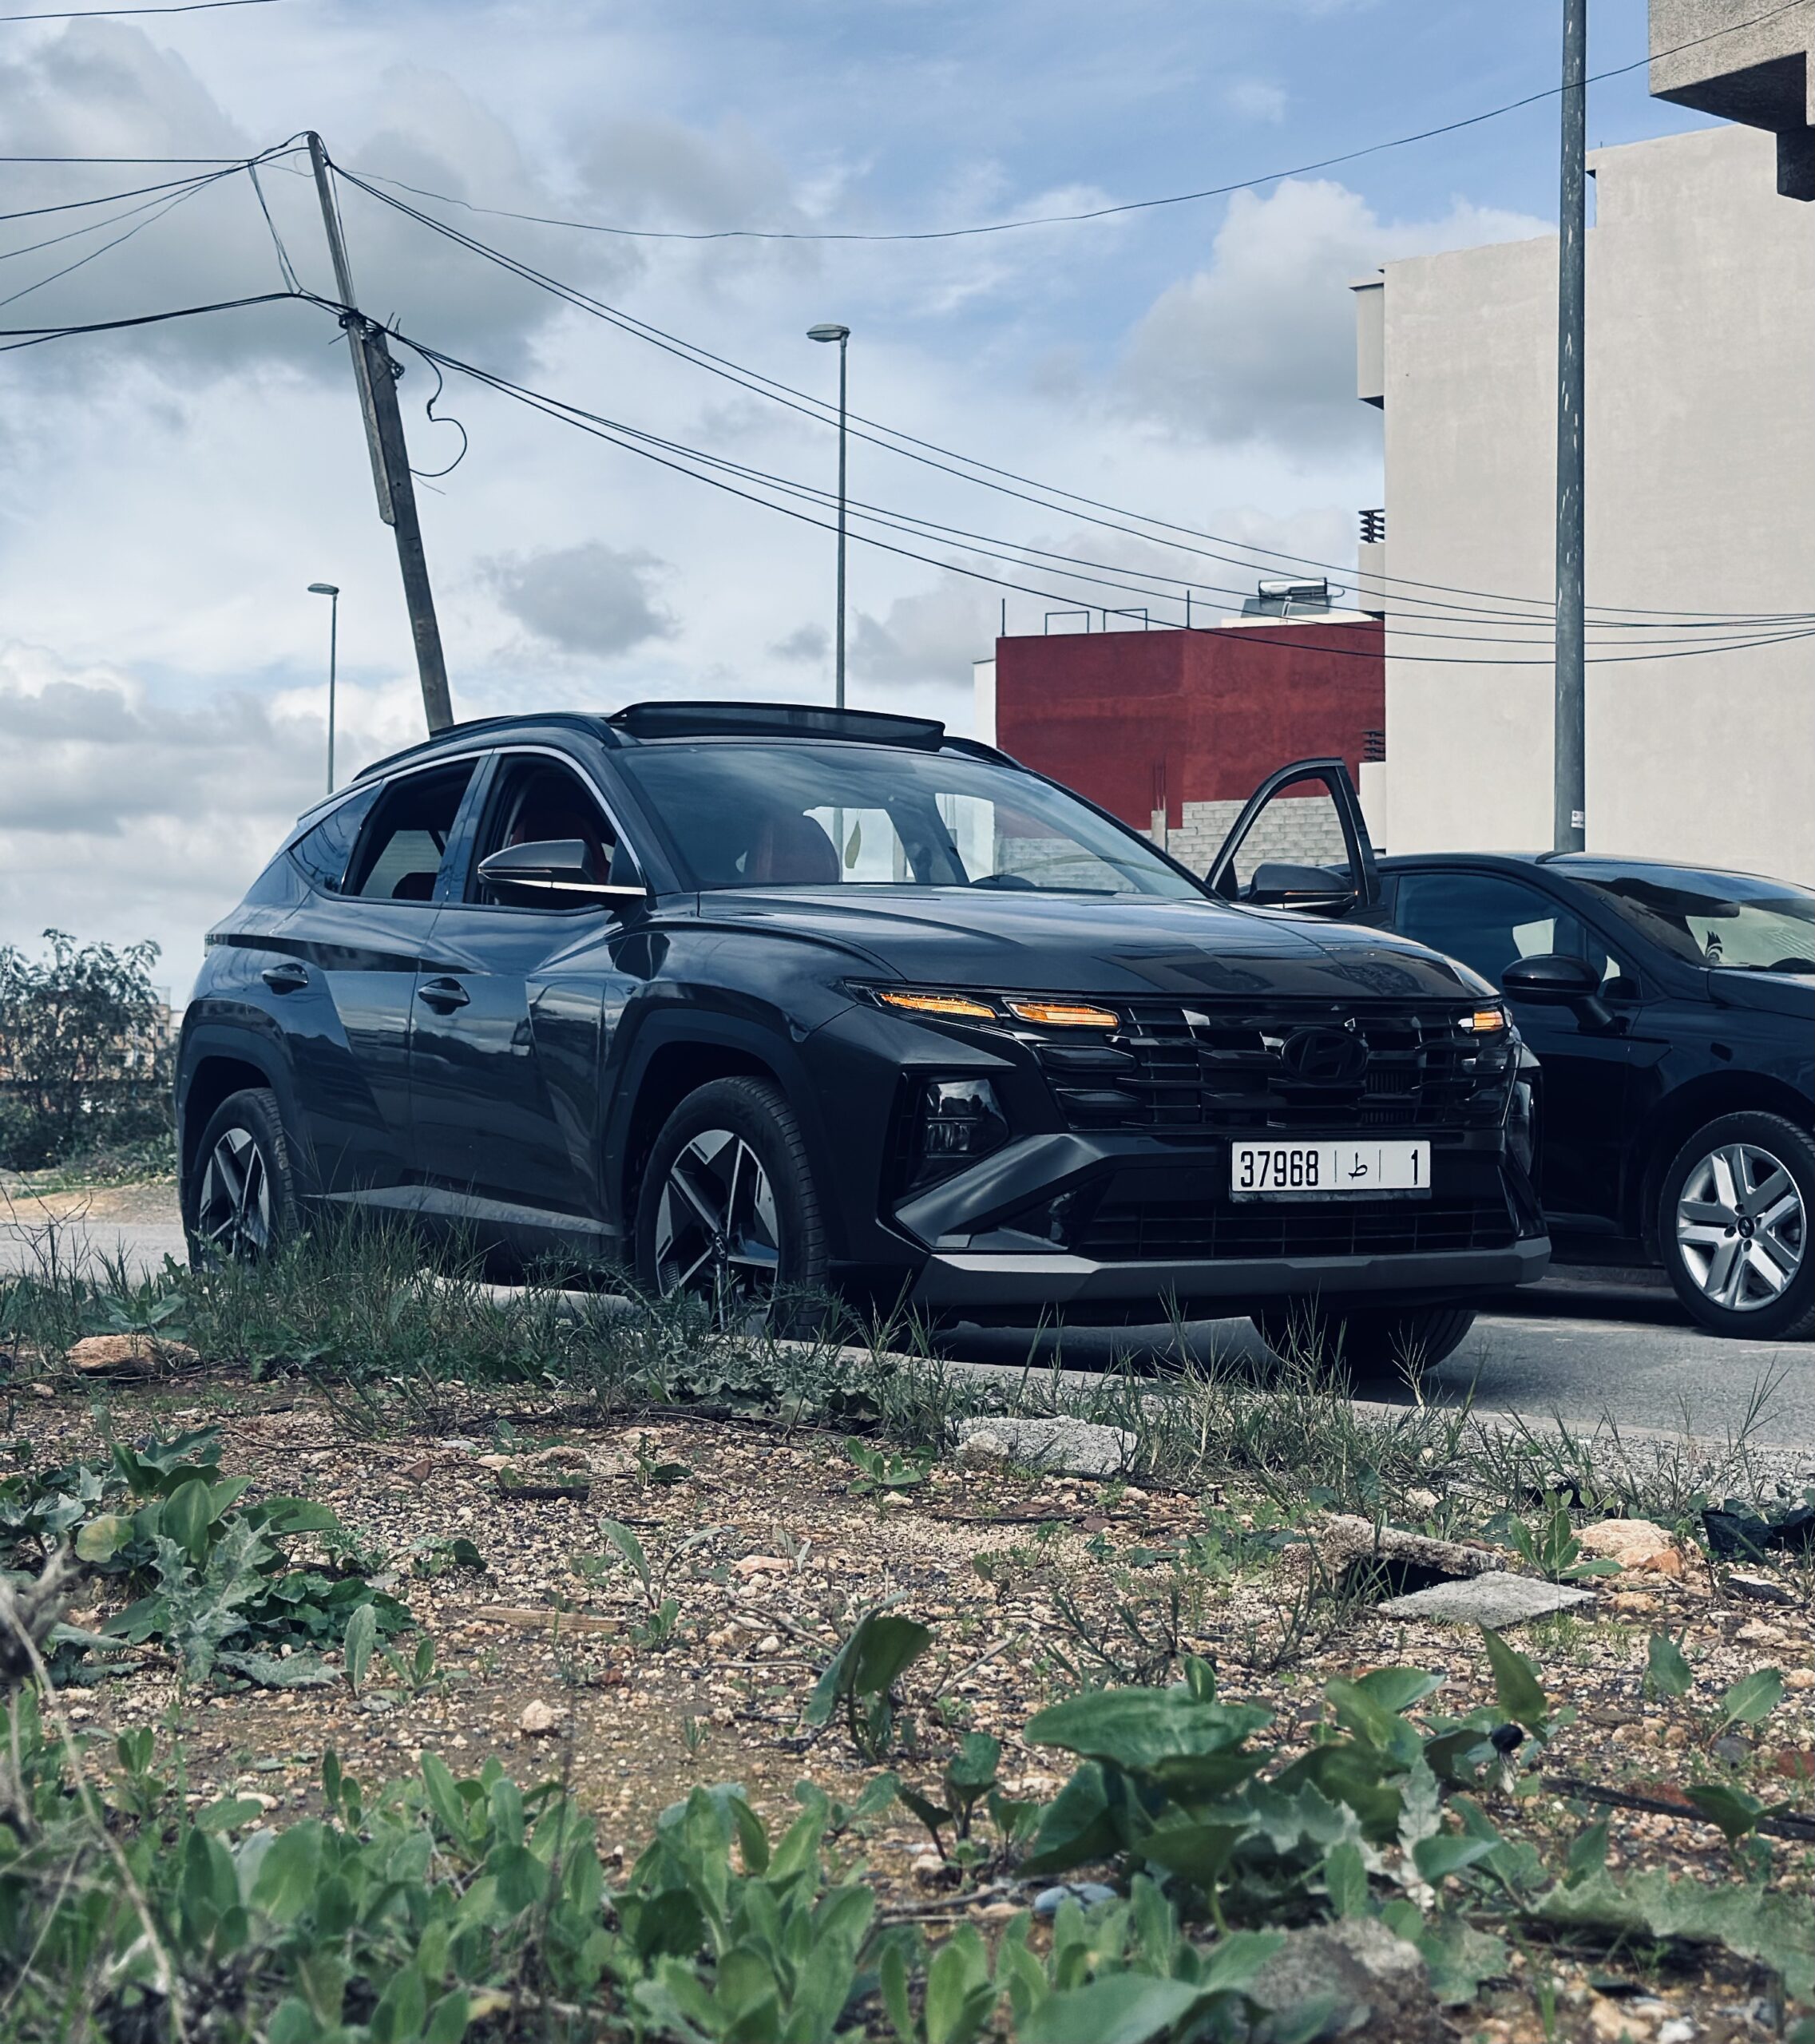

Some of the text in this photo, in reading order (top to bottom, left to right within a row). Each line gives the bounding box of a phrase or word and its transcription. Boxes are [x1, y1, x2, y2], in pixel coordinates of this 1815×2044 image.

[1240, 1150, 1418, 1187] 37968 ط 1
